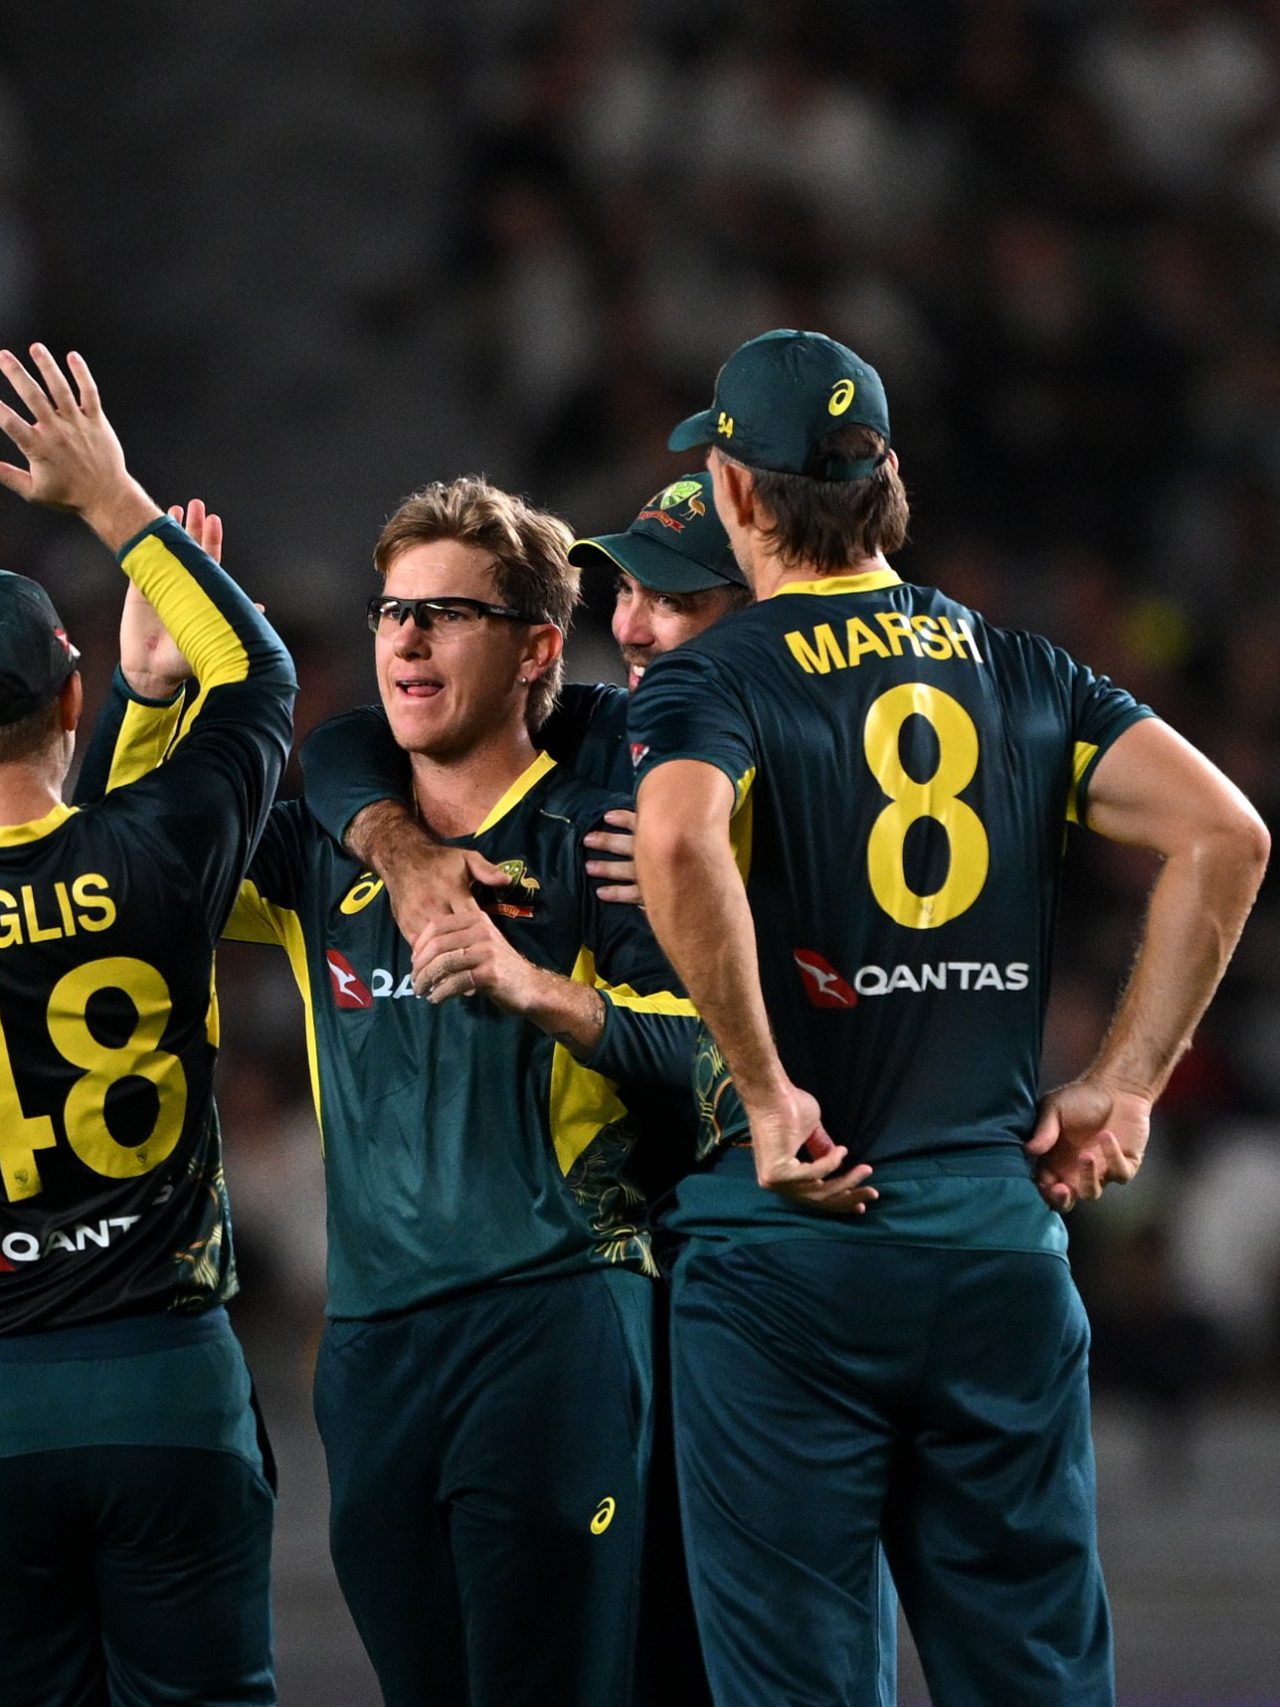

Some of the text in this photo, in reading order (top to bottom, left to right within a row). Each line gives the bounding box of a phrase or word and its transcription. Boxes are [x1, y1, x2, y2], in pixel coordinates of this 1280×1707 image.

[718, 412, 733, 438] 54
[784, 611, 983, 674] MARSH
[864, 683, 989, 929] 8
[854, 962, 1029, 996] QANTAS
